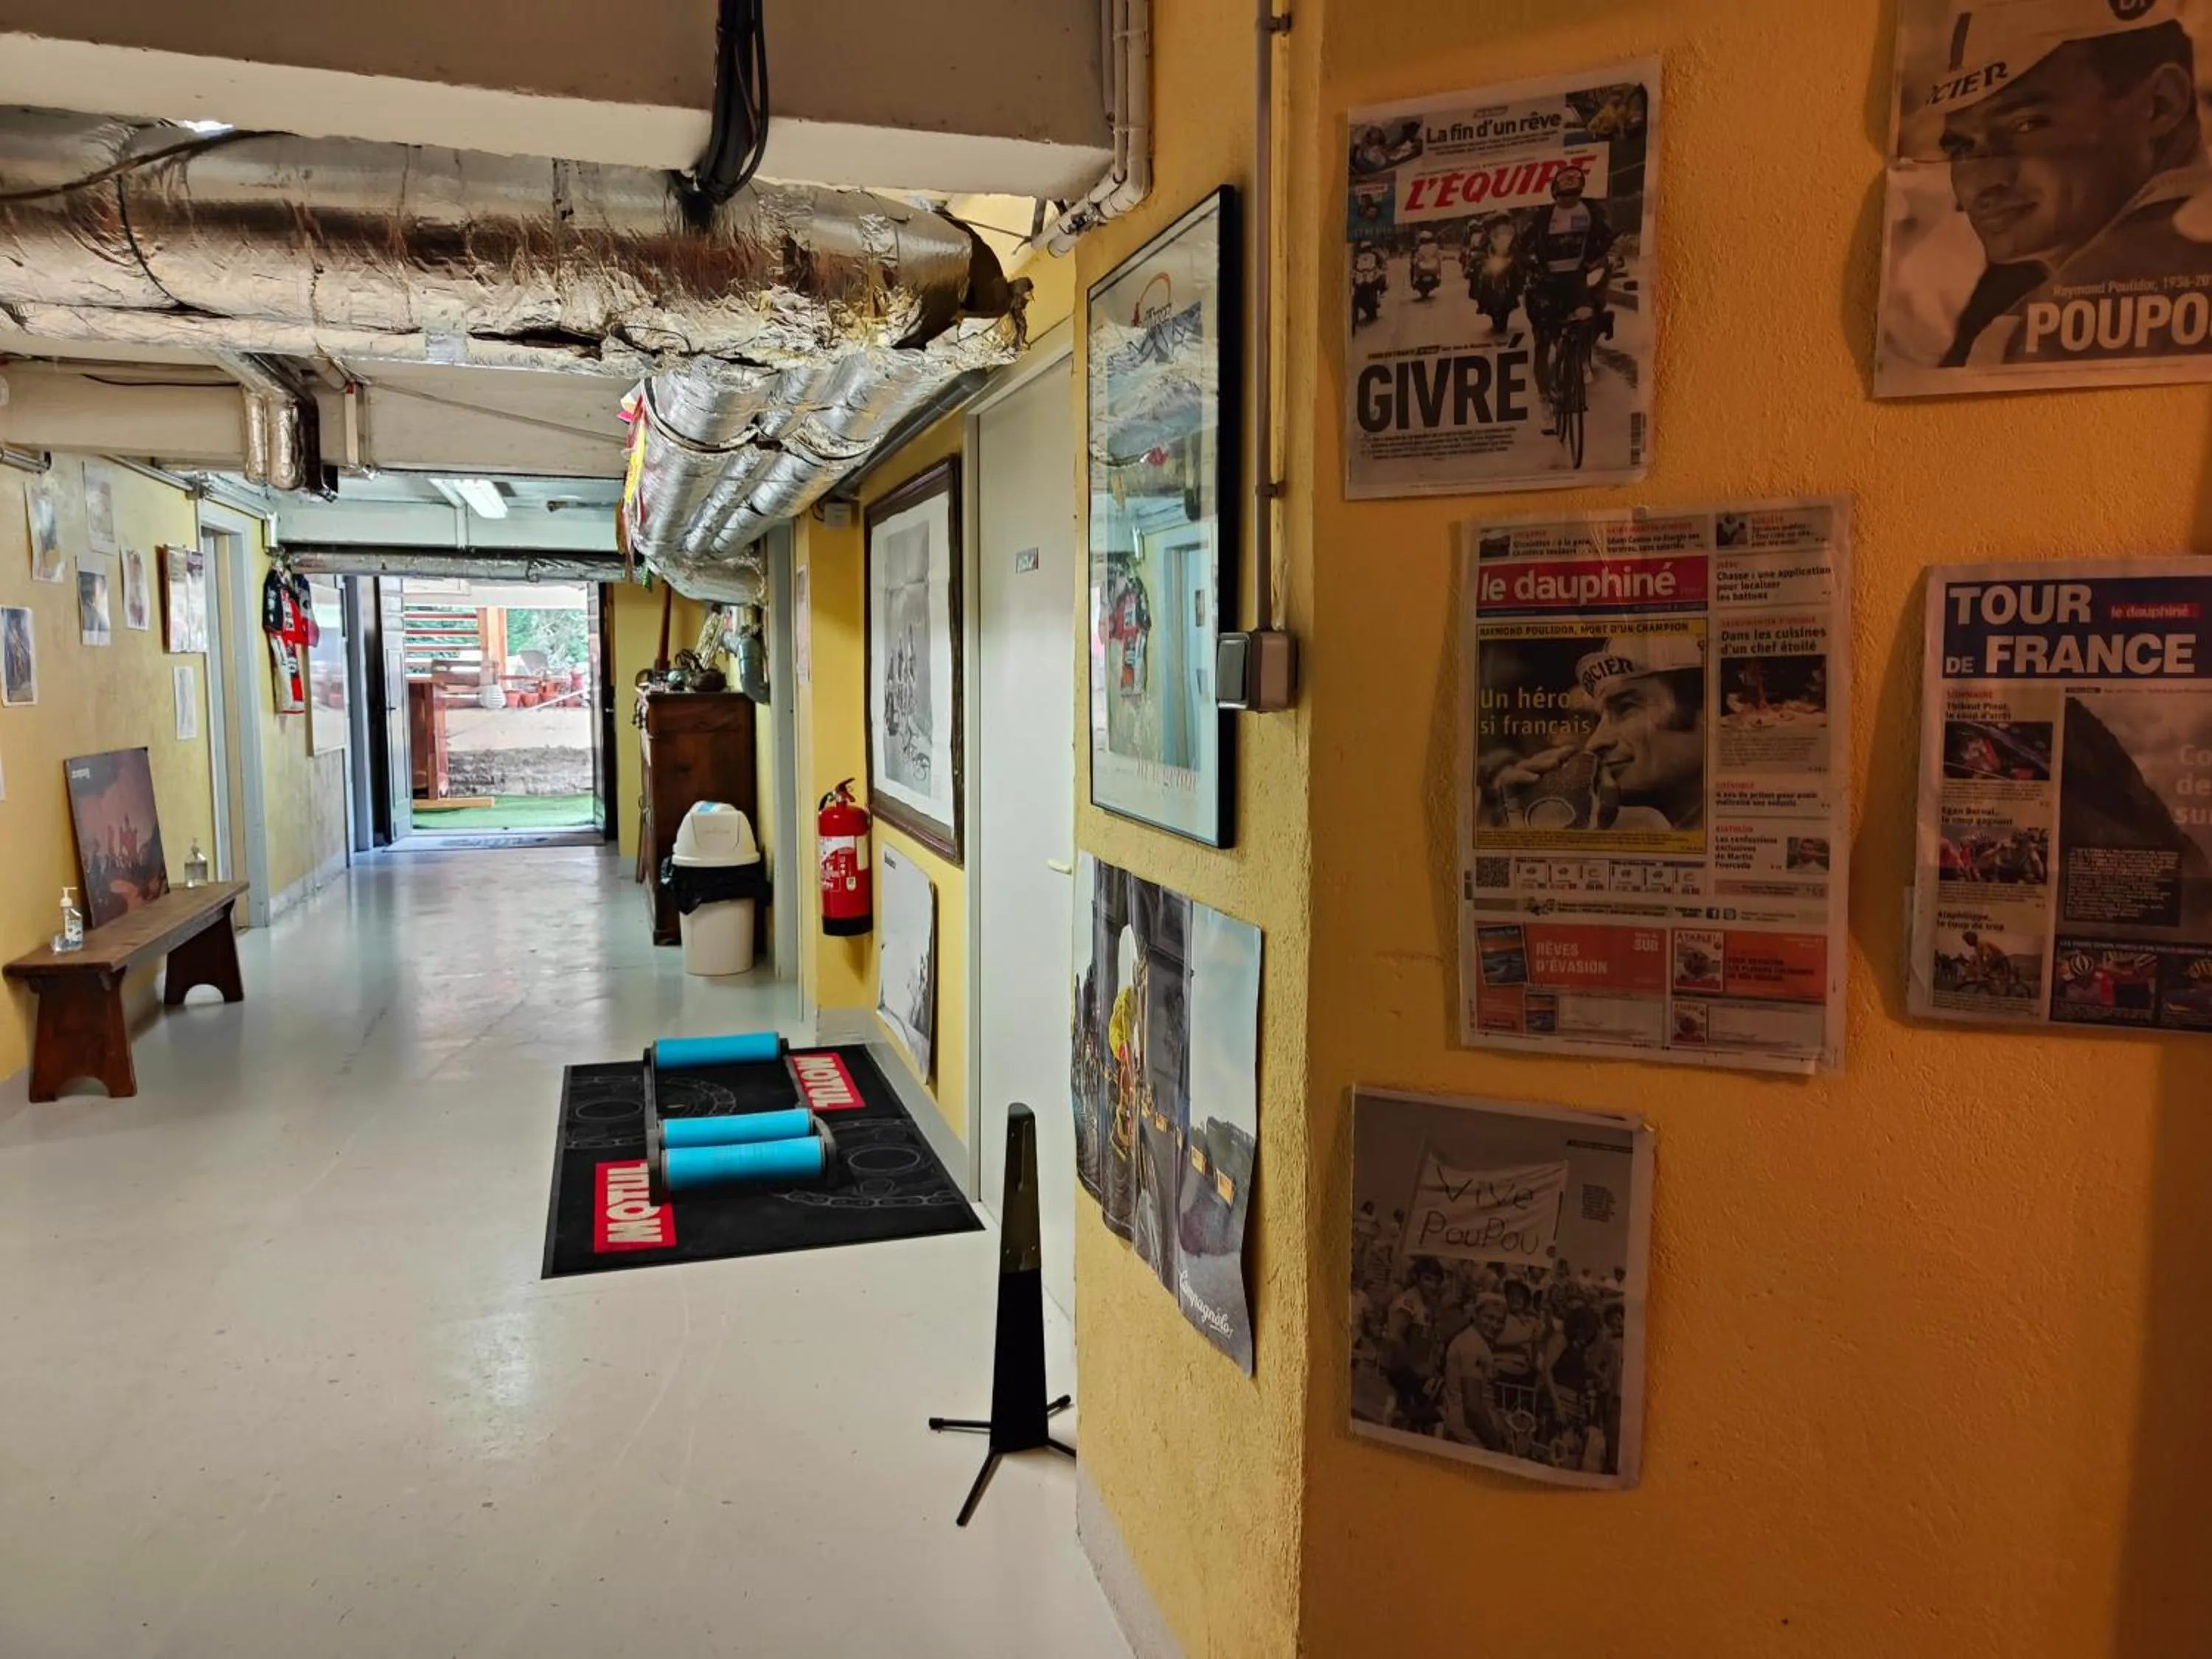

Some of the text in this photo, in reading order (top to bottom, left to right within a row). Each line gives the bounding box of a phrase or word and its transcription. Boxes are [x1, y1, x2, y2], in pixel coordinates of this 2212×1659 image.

[1925, 61, 2008, 108] CIER
[1426, 126, 1448, 145] La
[1450, 122, 1473, 141] fin
[1478, 118, 1517, 138] d'un
[1520, 111, 1562, 133] rêve
[2163, 271, 2212, 289] 1936-20
[2025, 291, 2212, 354] POUPO
[1357, 333, 1529, 432] GIVRÉ
[1480, 561, 1677, 606] le dauphiné
[1778, 566, 1831, 579] application
[1950, 583, 2093, 625] TOUR
[2110, 603, 2189, 620] le dauphiné
[1635, 621, 1688, 633] CHAMPION
[1721, 627, 1827, 642] Dans les cuisines
[1720, 639, 1817, 655] d'un chef étoilé
[1945, 633, 2197, 675] DE FRANCE
[1481, 688, 1508, 709] Un
[1480, 715, 1495, 734] si
[796, 1056, 854, 1107] MOTUL
[607, 1163, 662, 1242] MOTUL
[1180, 1269, 1234, 1340] Campagnolo
